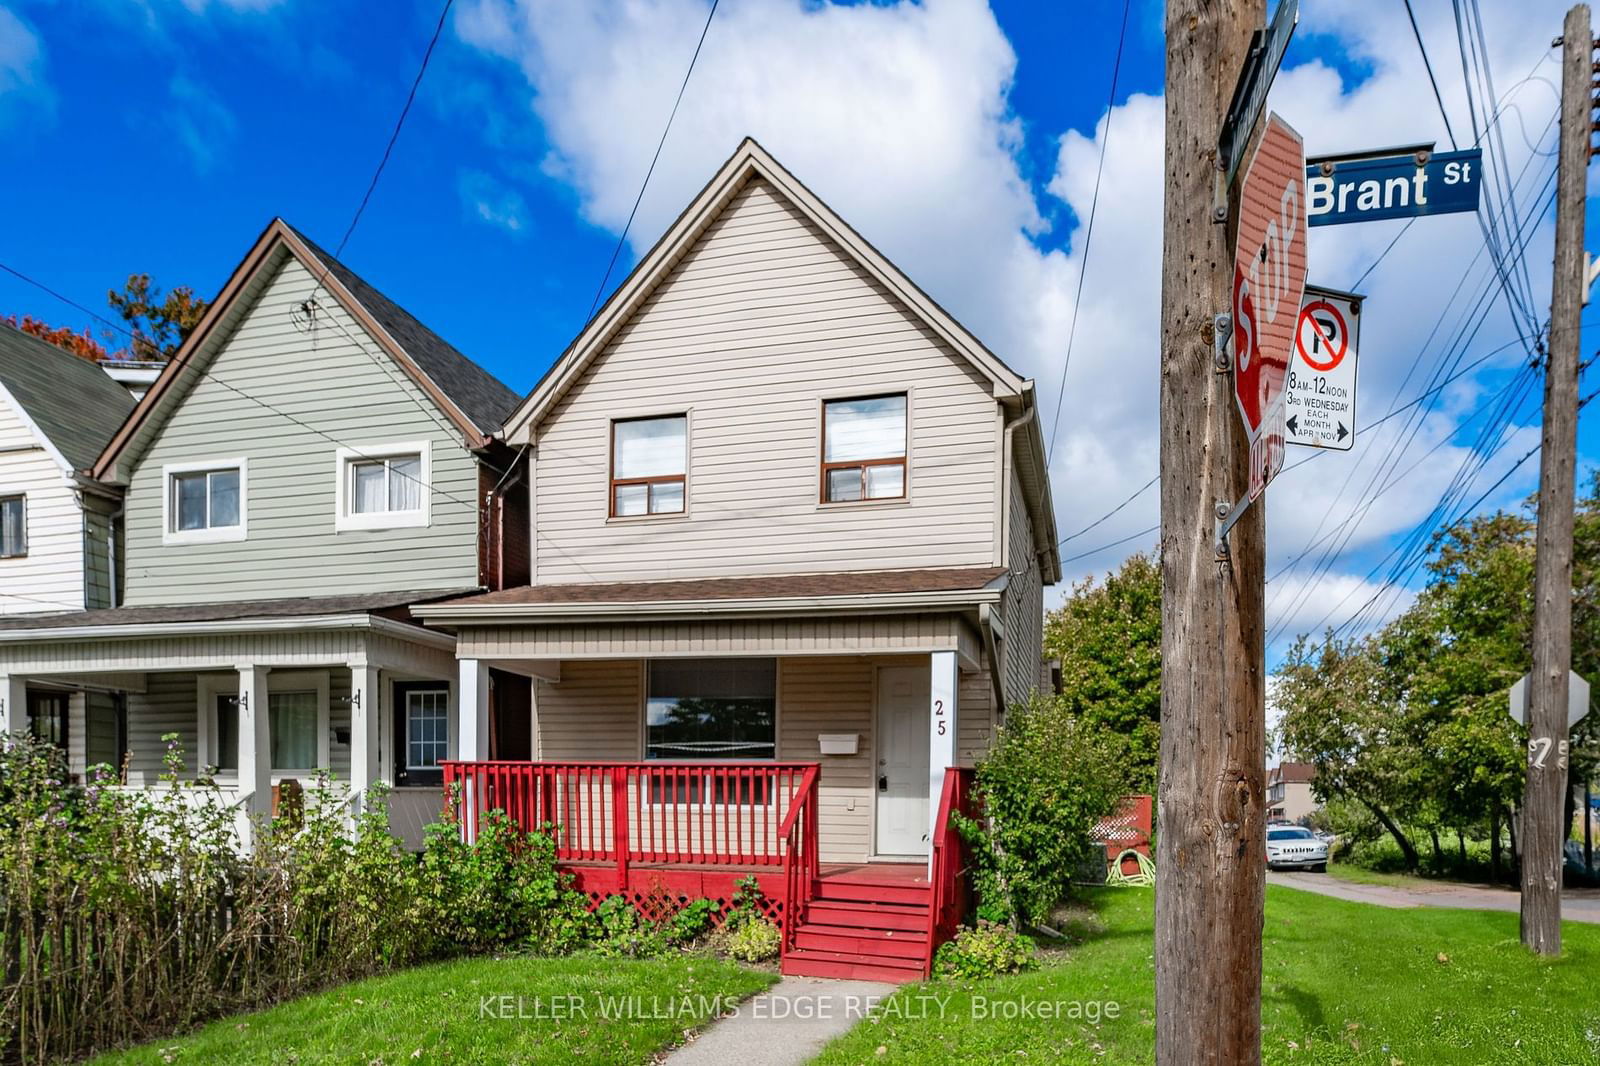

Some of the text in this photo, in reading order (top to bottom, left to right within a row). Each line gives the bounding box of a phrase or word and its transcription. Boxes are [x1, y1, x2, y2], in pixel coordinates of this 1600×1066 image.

[1307, 161, 1471, 216] Brant St
[1238, 178, 1298, 373] STOP
[1286, 391, 1349, 413] 3RD WEDNESDAY
[1304, 419, 1331, 430] MONTH
[1307, 409, 1329, 420] EACH
